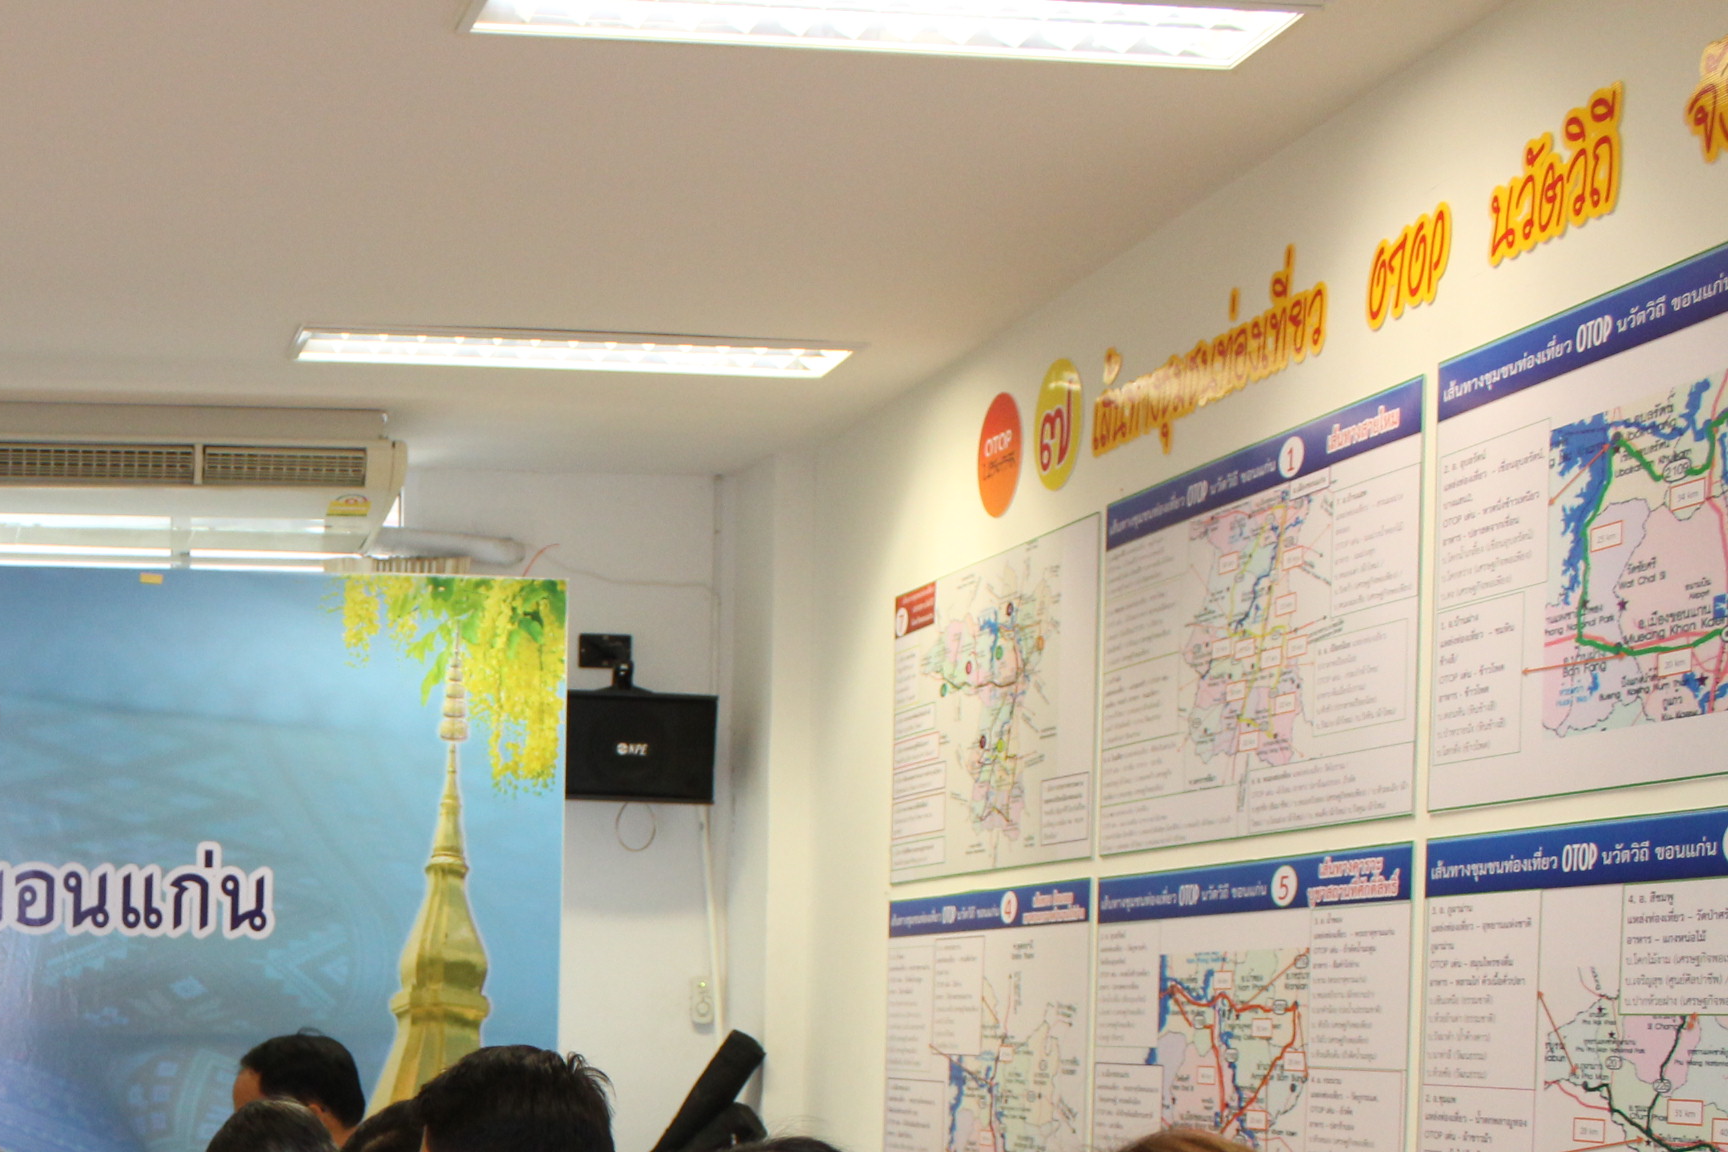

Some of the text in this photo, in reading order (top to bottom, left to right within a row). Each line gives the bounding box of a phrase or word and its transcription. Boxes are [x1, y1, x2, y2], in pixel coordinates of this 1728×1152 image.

[1489, 80, 1625, 267] นวัตวิถี
[1443, 335, 1572, 402] เส้นทางชุมชนท่องเที่ยว
[1575, 314, 1612, 353] OTOP
[1616, 295, 1667, 334] นวัตวิถี
[984, 429, 1012, 457] OTOP
[1431, 837, 1718, 881] เส้นทางชุมชนท่องเที่ยว OTOP นวัตวิถี ขอนแก่น
